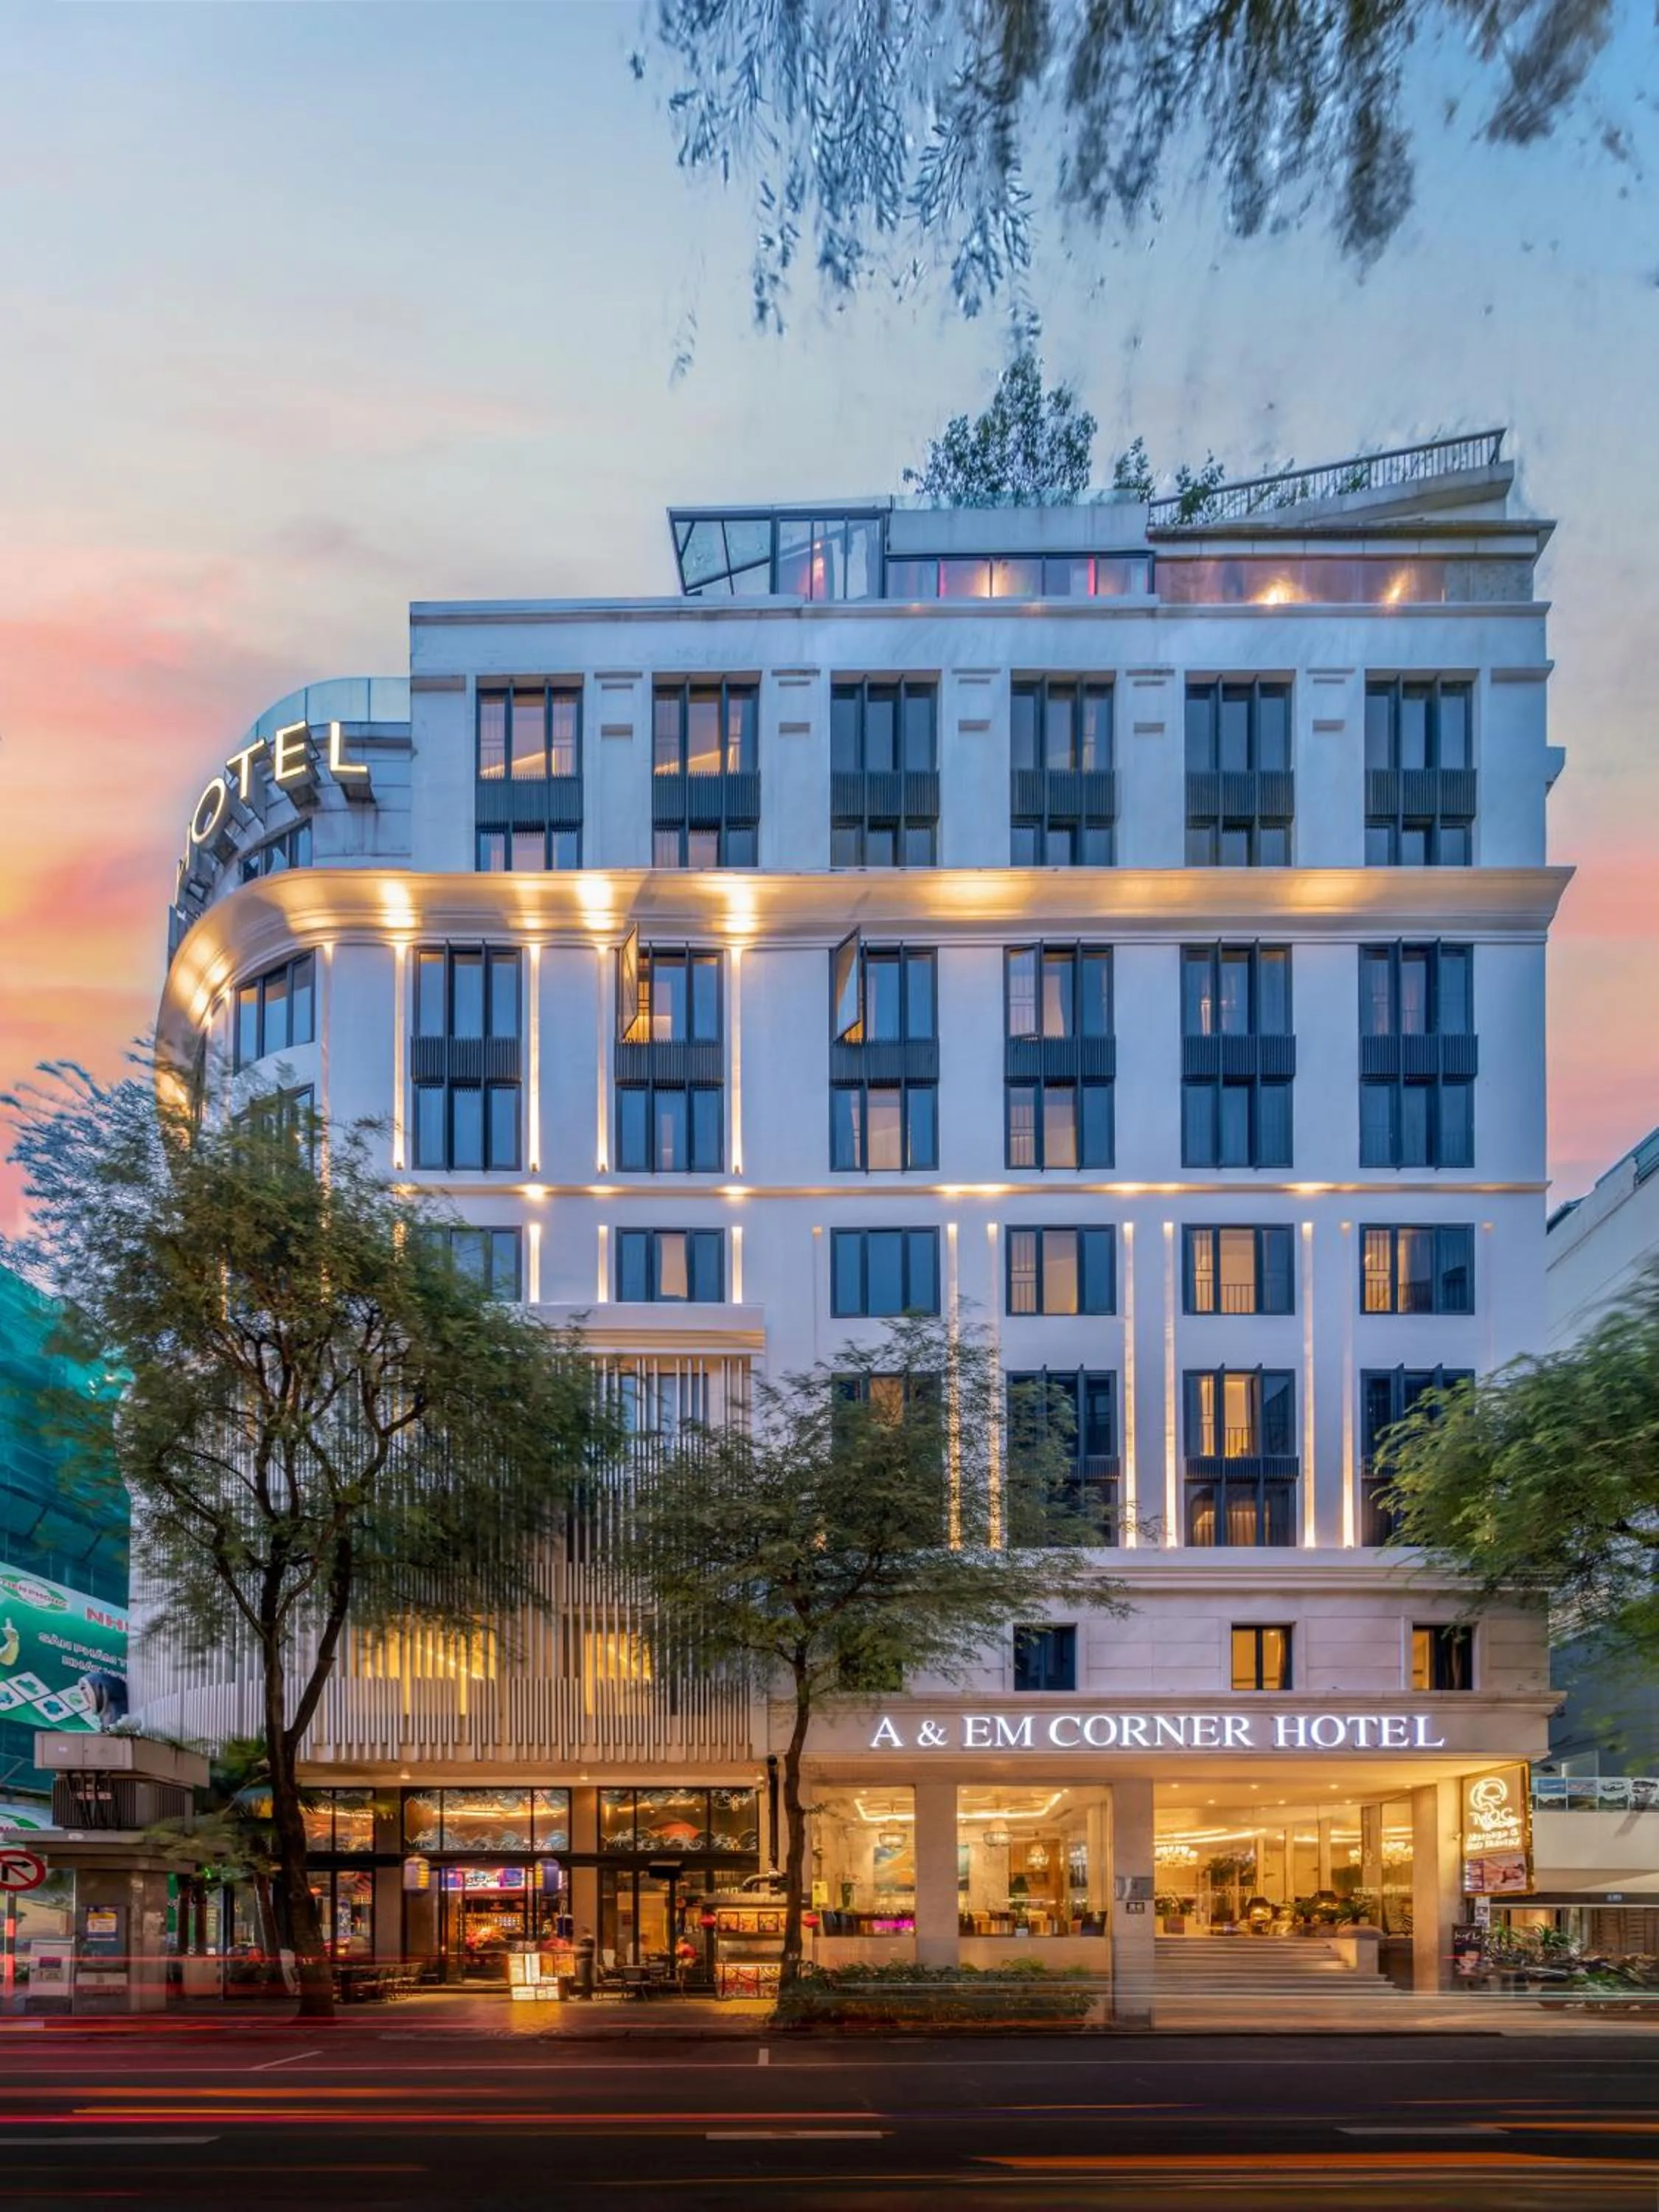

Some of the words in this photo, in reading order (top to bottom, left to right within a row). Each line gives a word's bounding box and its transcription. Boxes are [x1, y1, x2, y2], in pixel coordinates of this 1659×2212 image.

[86, 1606, 128, 1632] NH
[869, 1716, 904, 1747] A
[917, 1719, 949, 1747] &
[961, 1715, 1035, 1747] EM
[1048, 1714, 1256, 1747] CORNER
[1273, 1714, 1446, 1748] HOTEL
